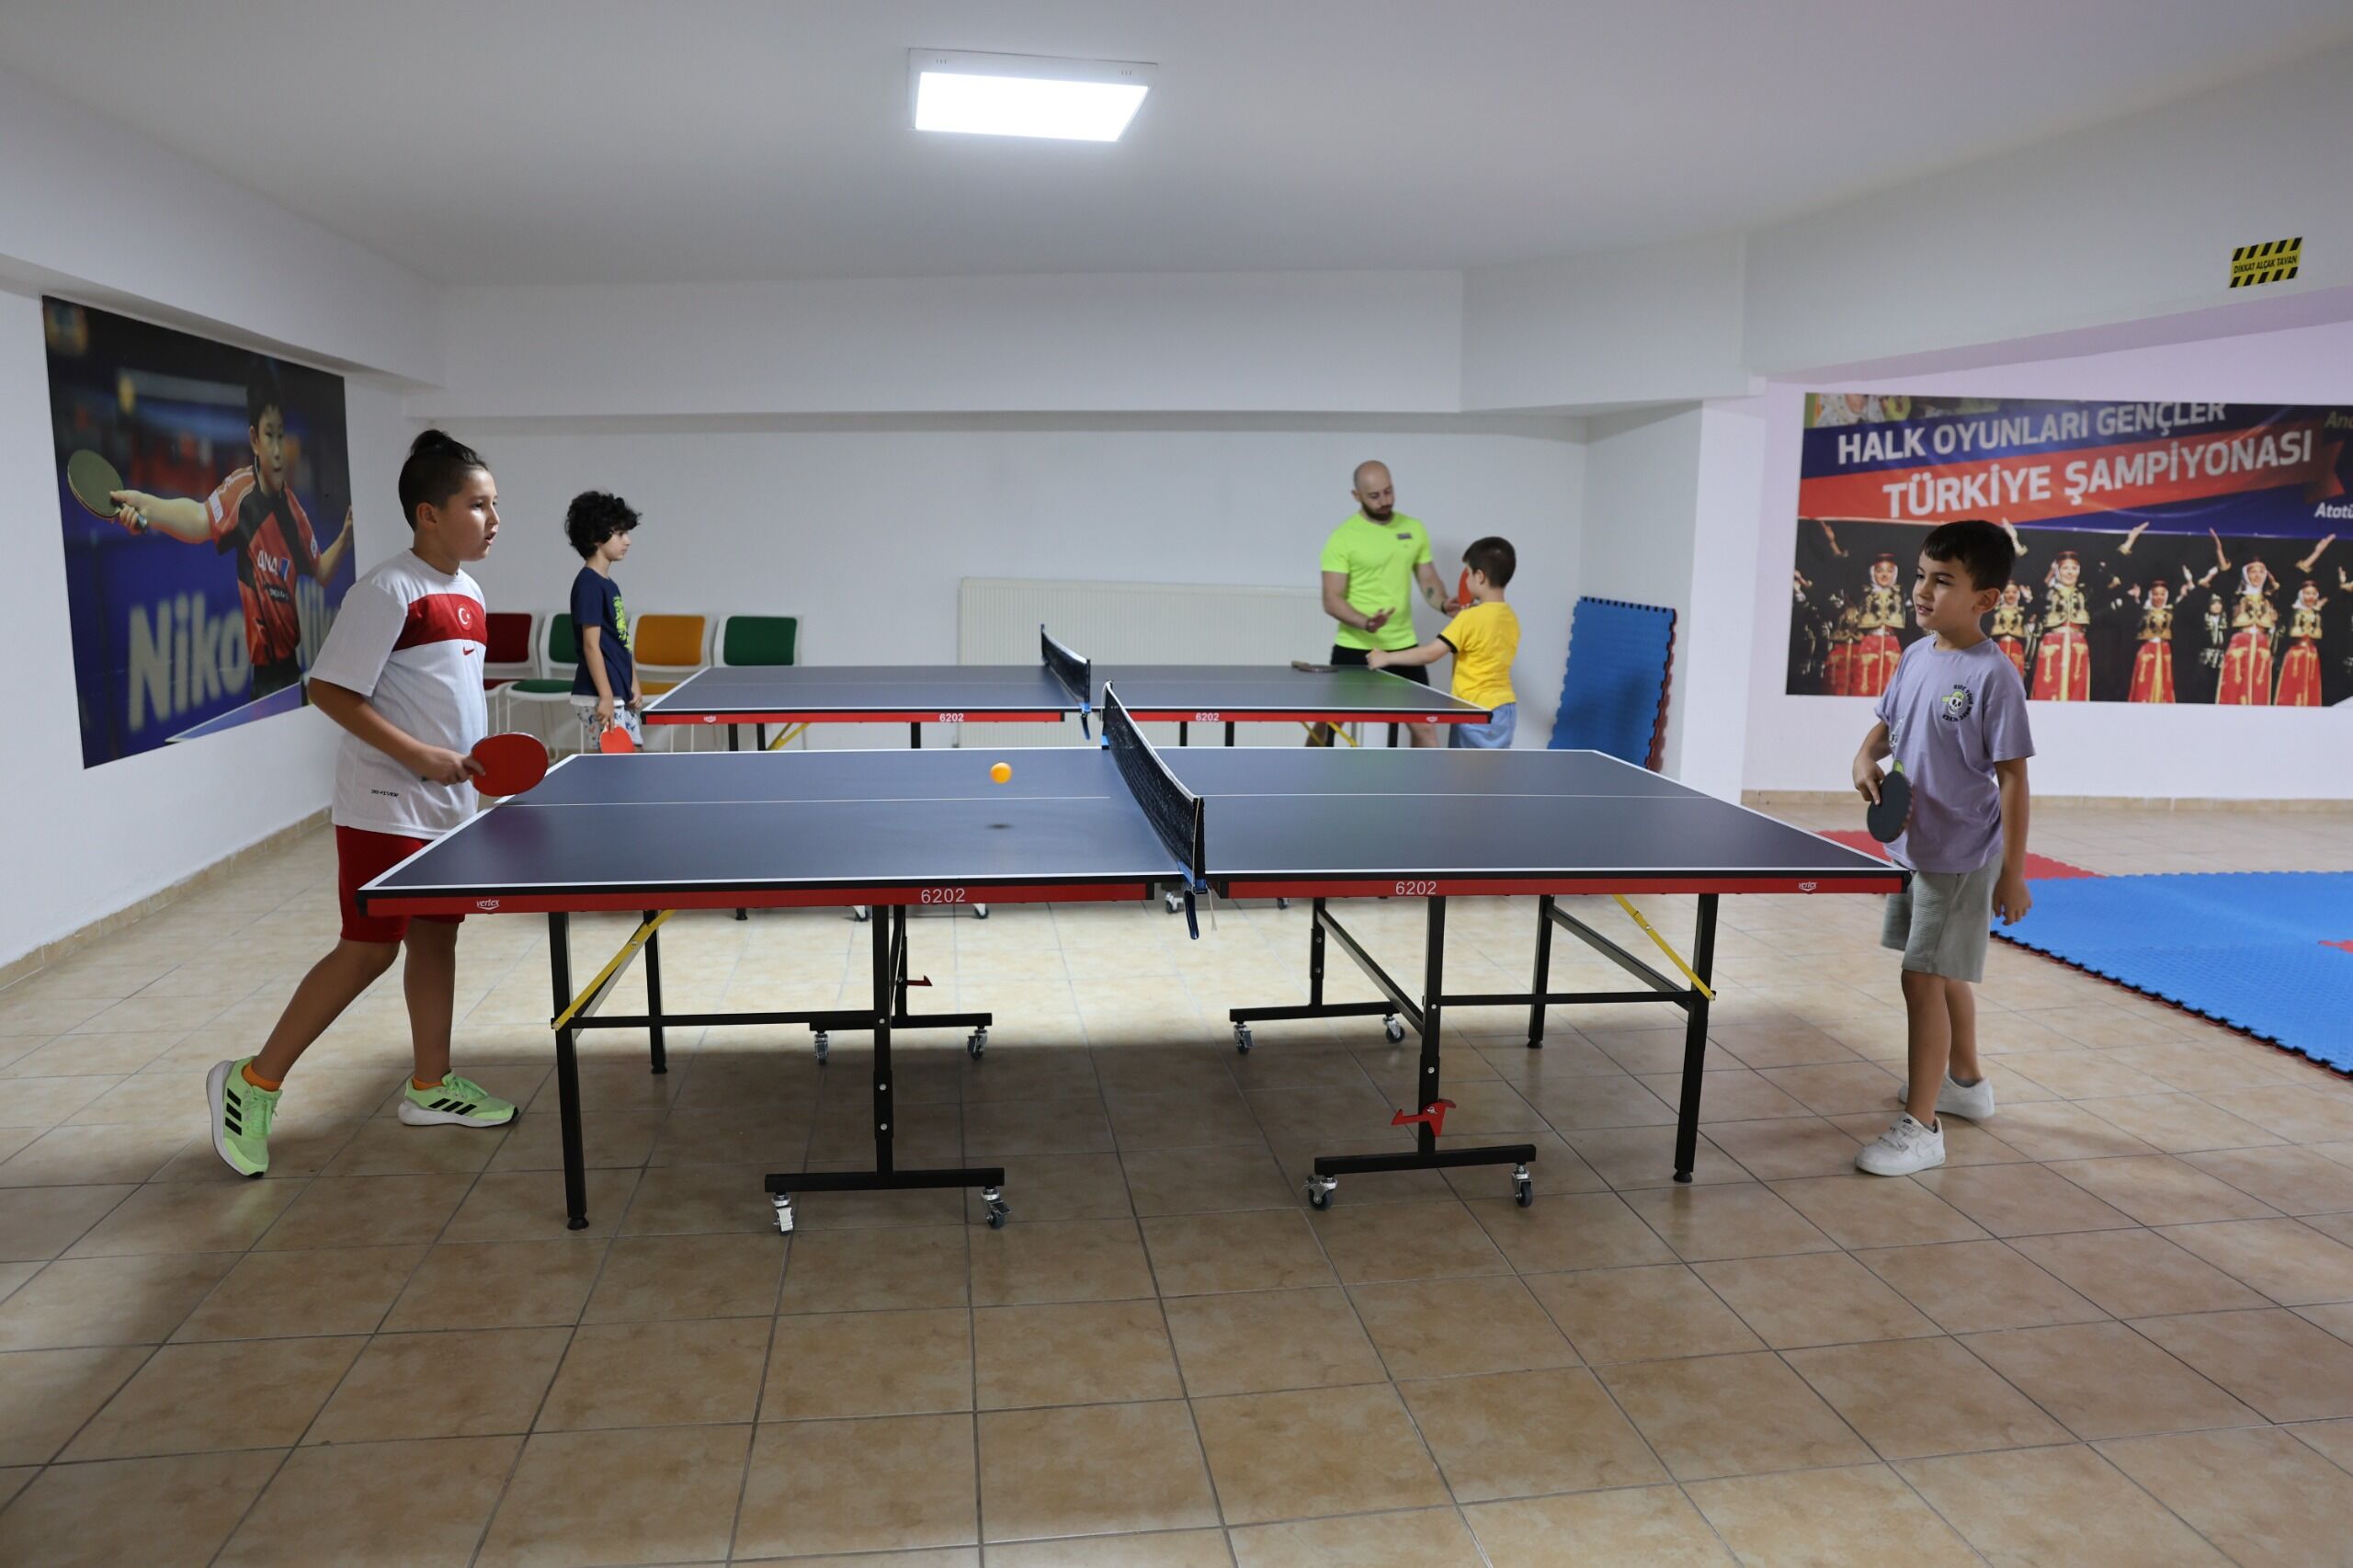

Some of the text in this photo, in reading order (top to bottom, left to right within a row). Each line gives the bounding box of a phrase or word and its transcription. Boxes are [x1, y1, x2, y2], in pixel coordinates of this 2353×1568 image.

[2277, 256, 2298, 267] TAVAN
[1838, 402, 2226, 465] HALK OYUNLARI GENÇLER
[1882, 429, 2313, 518] TÜRKİYE ŞAMPİYONASI
[939, 712, 964, 722] 6202
[1195, 712, 1220, 722] 6202
[1395, 881, 1438, 895] 6202
[921, 888, 966, 904] 6202
